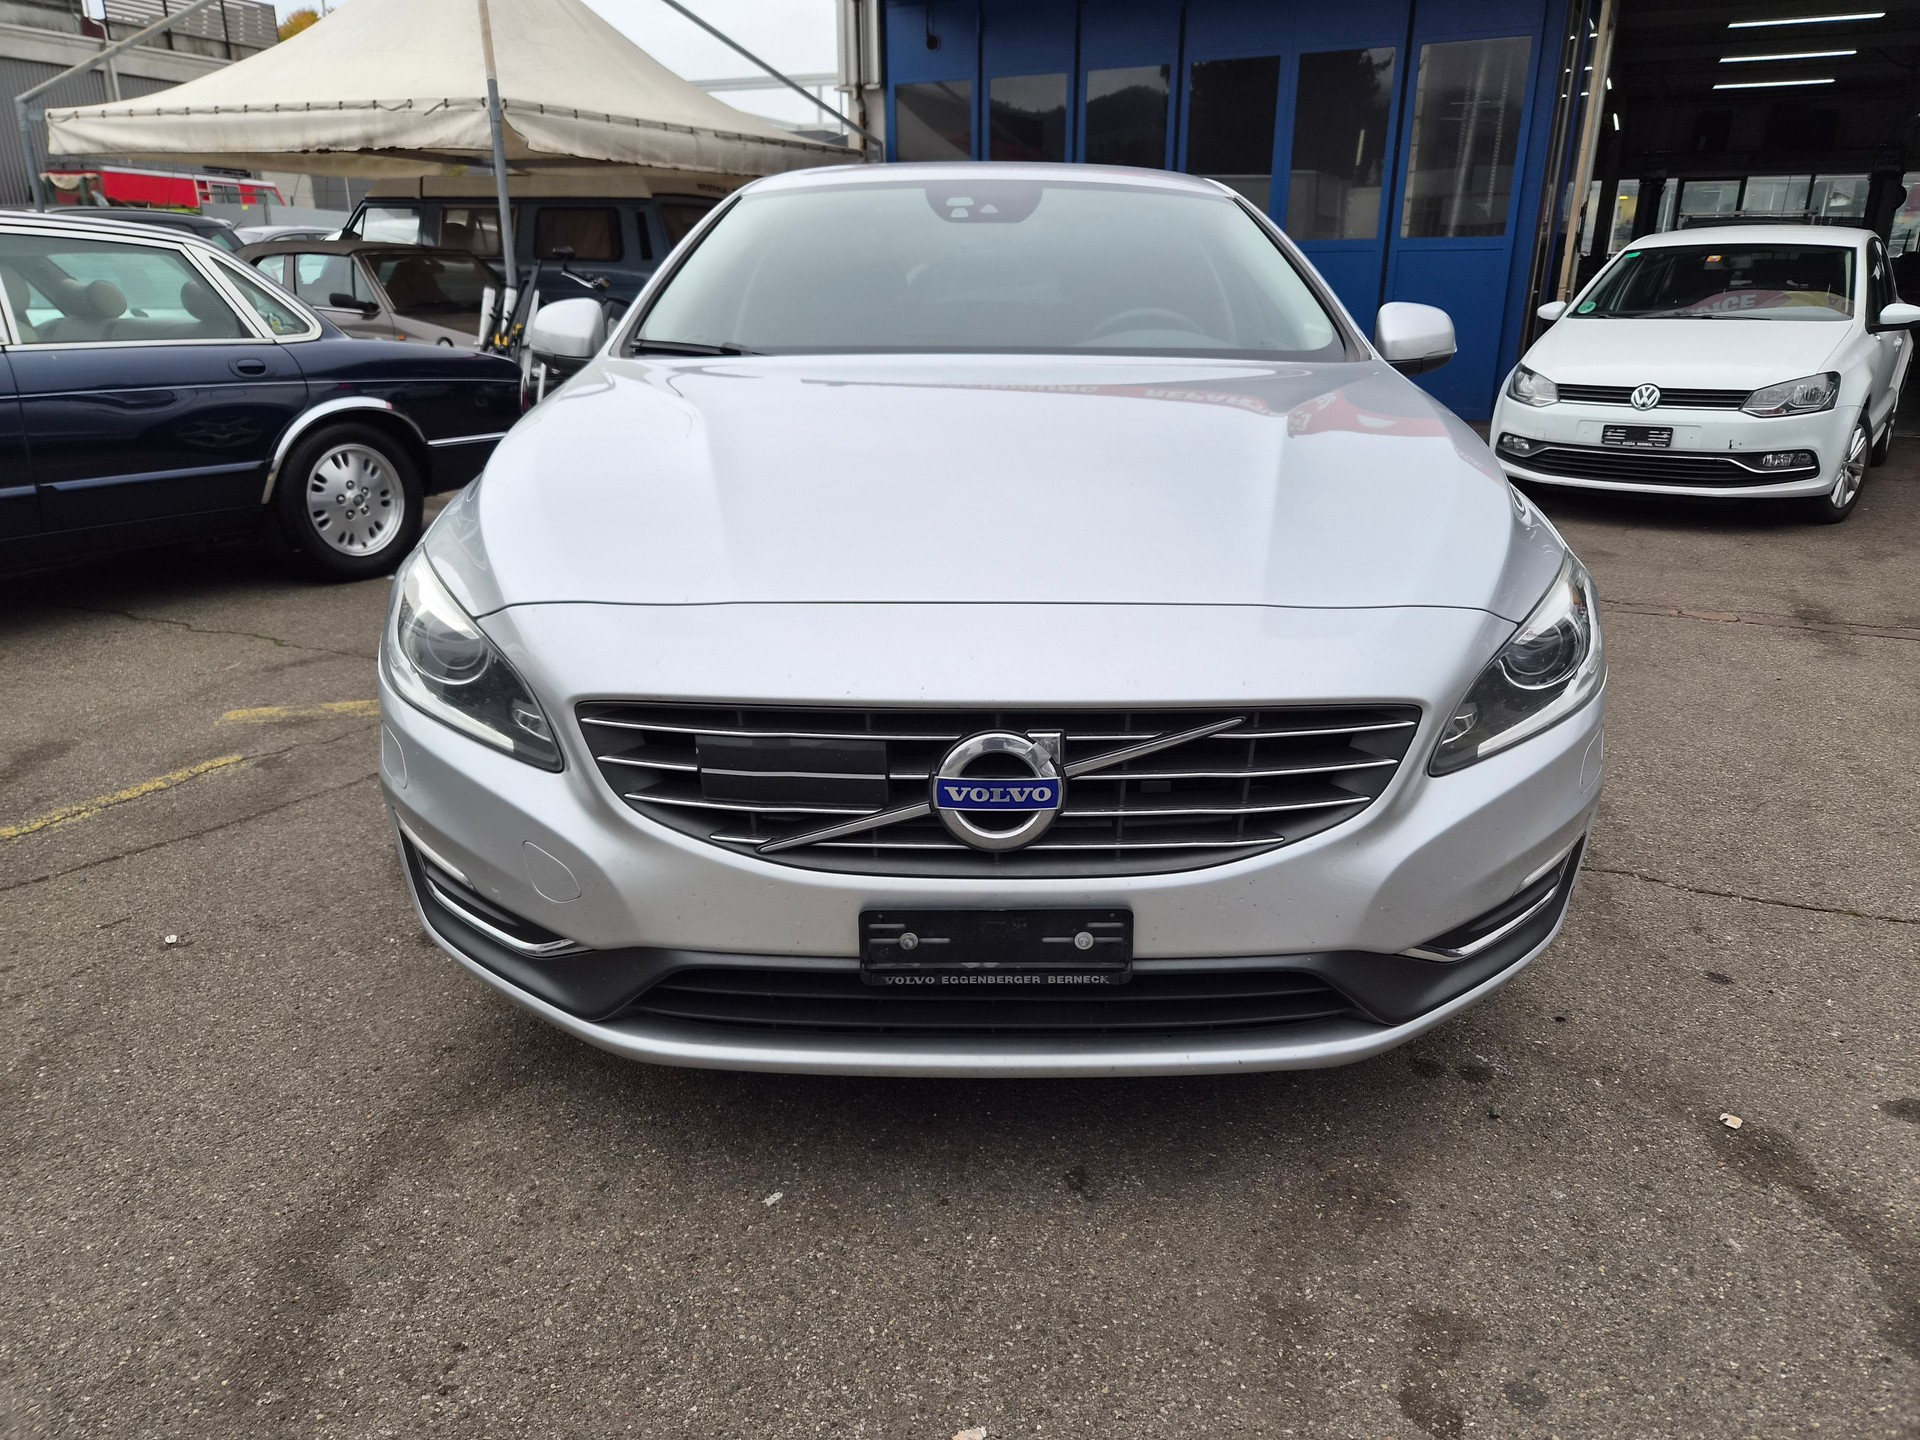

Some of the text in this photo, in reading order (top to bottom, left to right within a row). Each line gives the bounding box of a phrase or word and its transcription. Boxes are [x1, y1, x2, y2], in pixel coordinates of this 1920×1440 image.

[944, 786, 1052, 803] VOLVO
[883, 975, 1110, 985] VOLVO EGGENBERGER BERNECK
